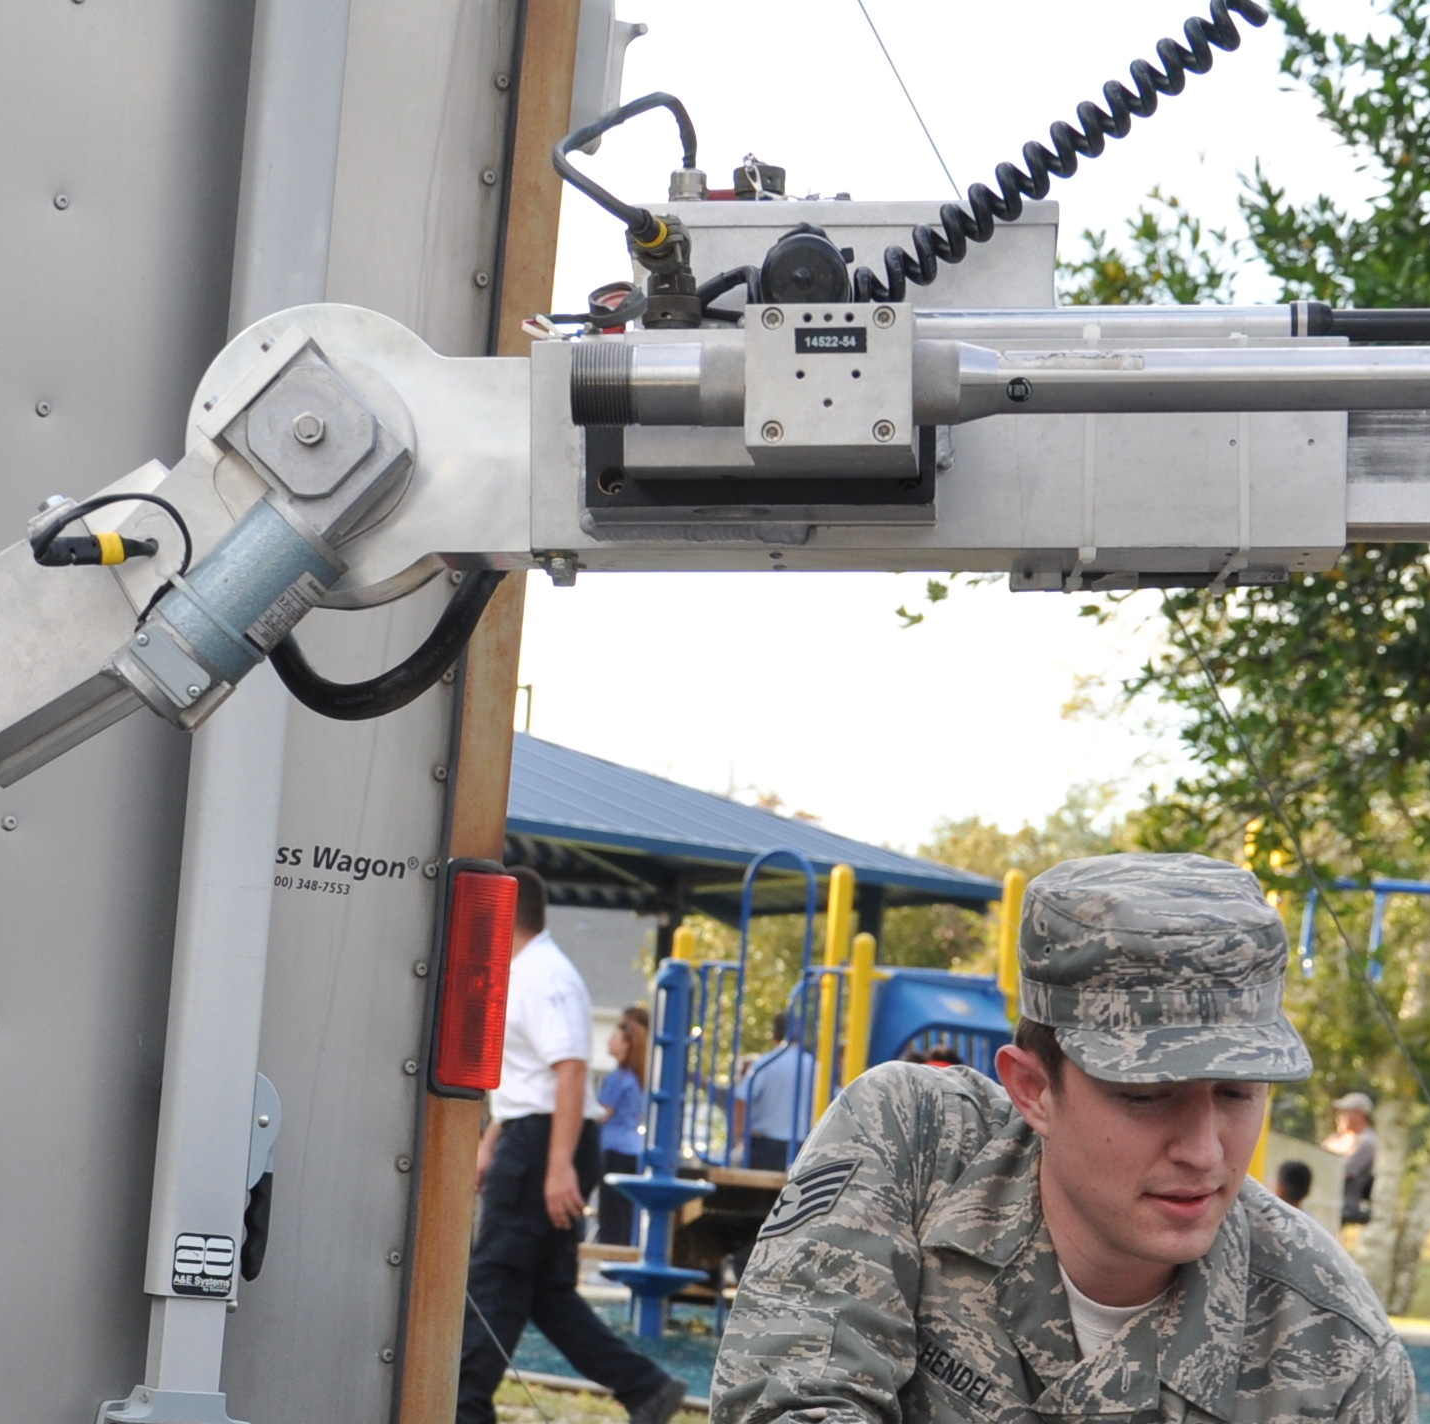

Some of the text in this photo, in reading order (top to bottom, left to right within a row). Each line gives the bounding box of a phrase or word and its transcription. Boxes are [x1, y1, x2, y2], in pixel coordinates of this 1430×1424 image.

[804, 336, 857, 348] 14522-54
[296, 878, 351, 896] 348-7553
[173, 1274, 231, 1288] A&E Systems
[921, 1342, 992, 1410] HENDEL
